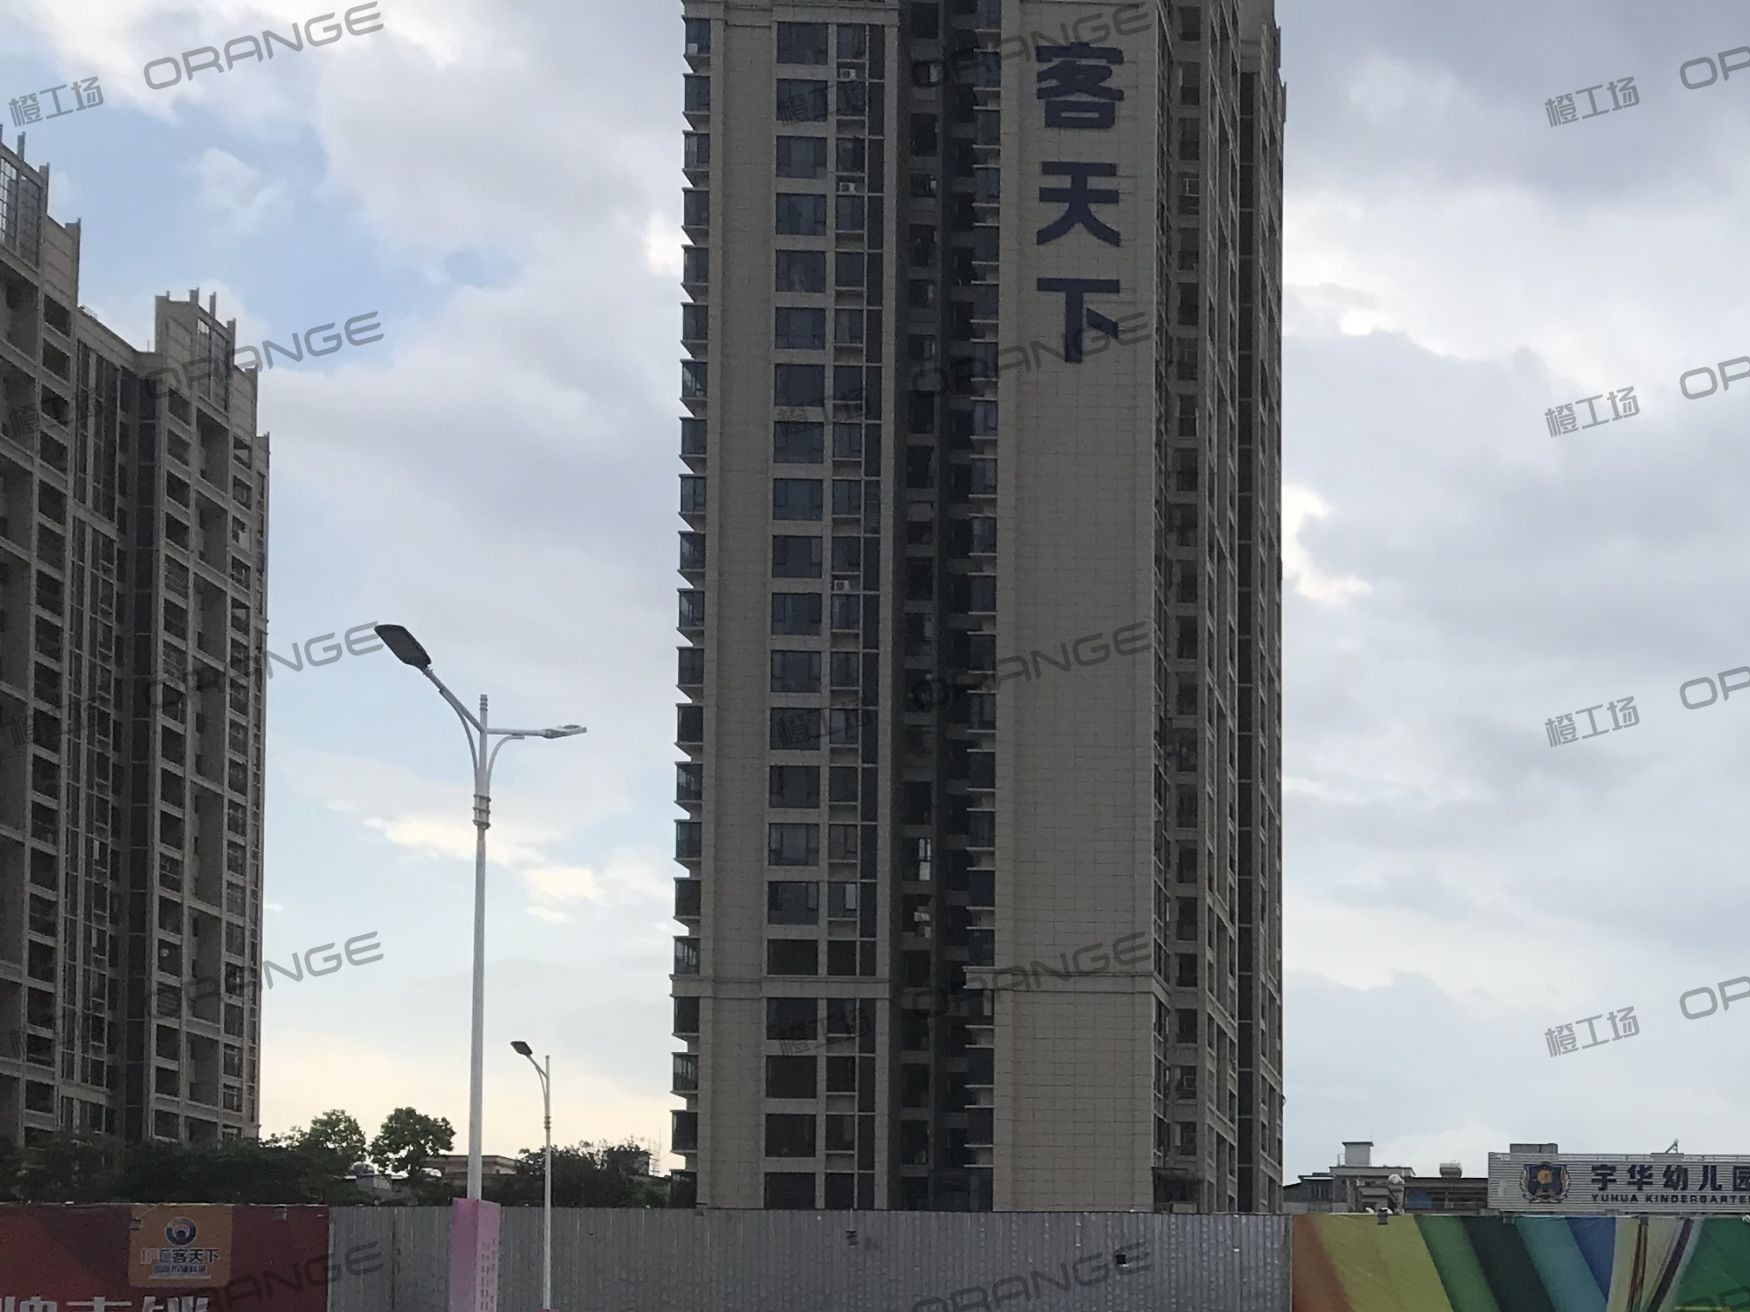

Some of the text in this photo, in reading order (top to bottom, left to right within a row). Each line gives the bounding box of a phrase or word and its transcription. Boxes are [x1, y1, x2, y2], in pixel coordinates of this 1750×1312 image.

[1036, 41, 1125, 364] 客天下
[1591, 1194, 1638, 1204] YUHUA
